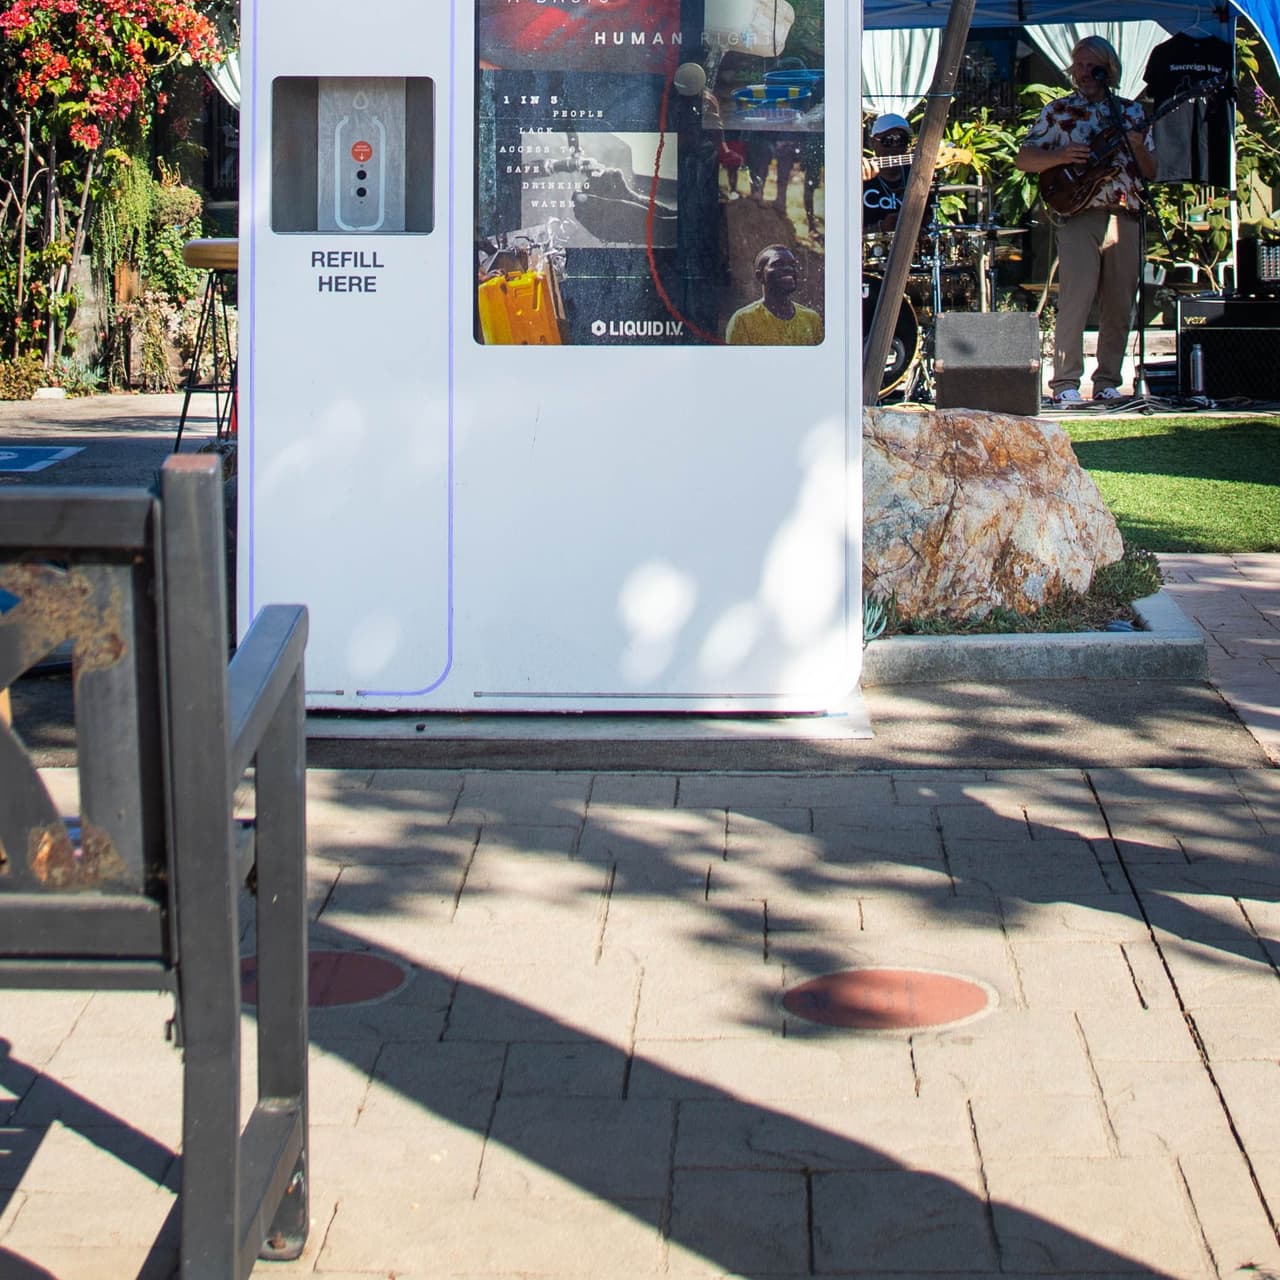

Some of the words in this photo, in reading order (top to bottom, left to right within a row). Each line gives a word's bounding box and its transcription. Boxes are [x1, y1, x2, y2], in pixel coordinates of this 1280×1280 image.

[594, 31, 683, 46] HUMAN
[503, 95, 510, 104] 1
[521, 95, 540, 104] IN
[552, 110, 604, 118] PEOPLE
[499, 145, 550, 153] ACCESS
[522, 182, 591, 190] DRINKING
[531, 200, 576, 208] WATER
[311, 251, 385, 268] REFILL
[318, 276, 377, 293] HERE
[609, 321, 666, 337] LIQUID
